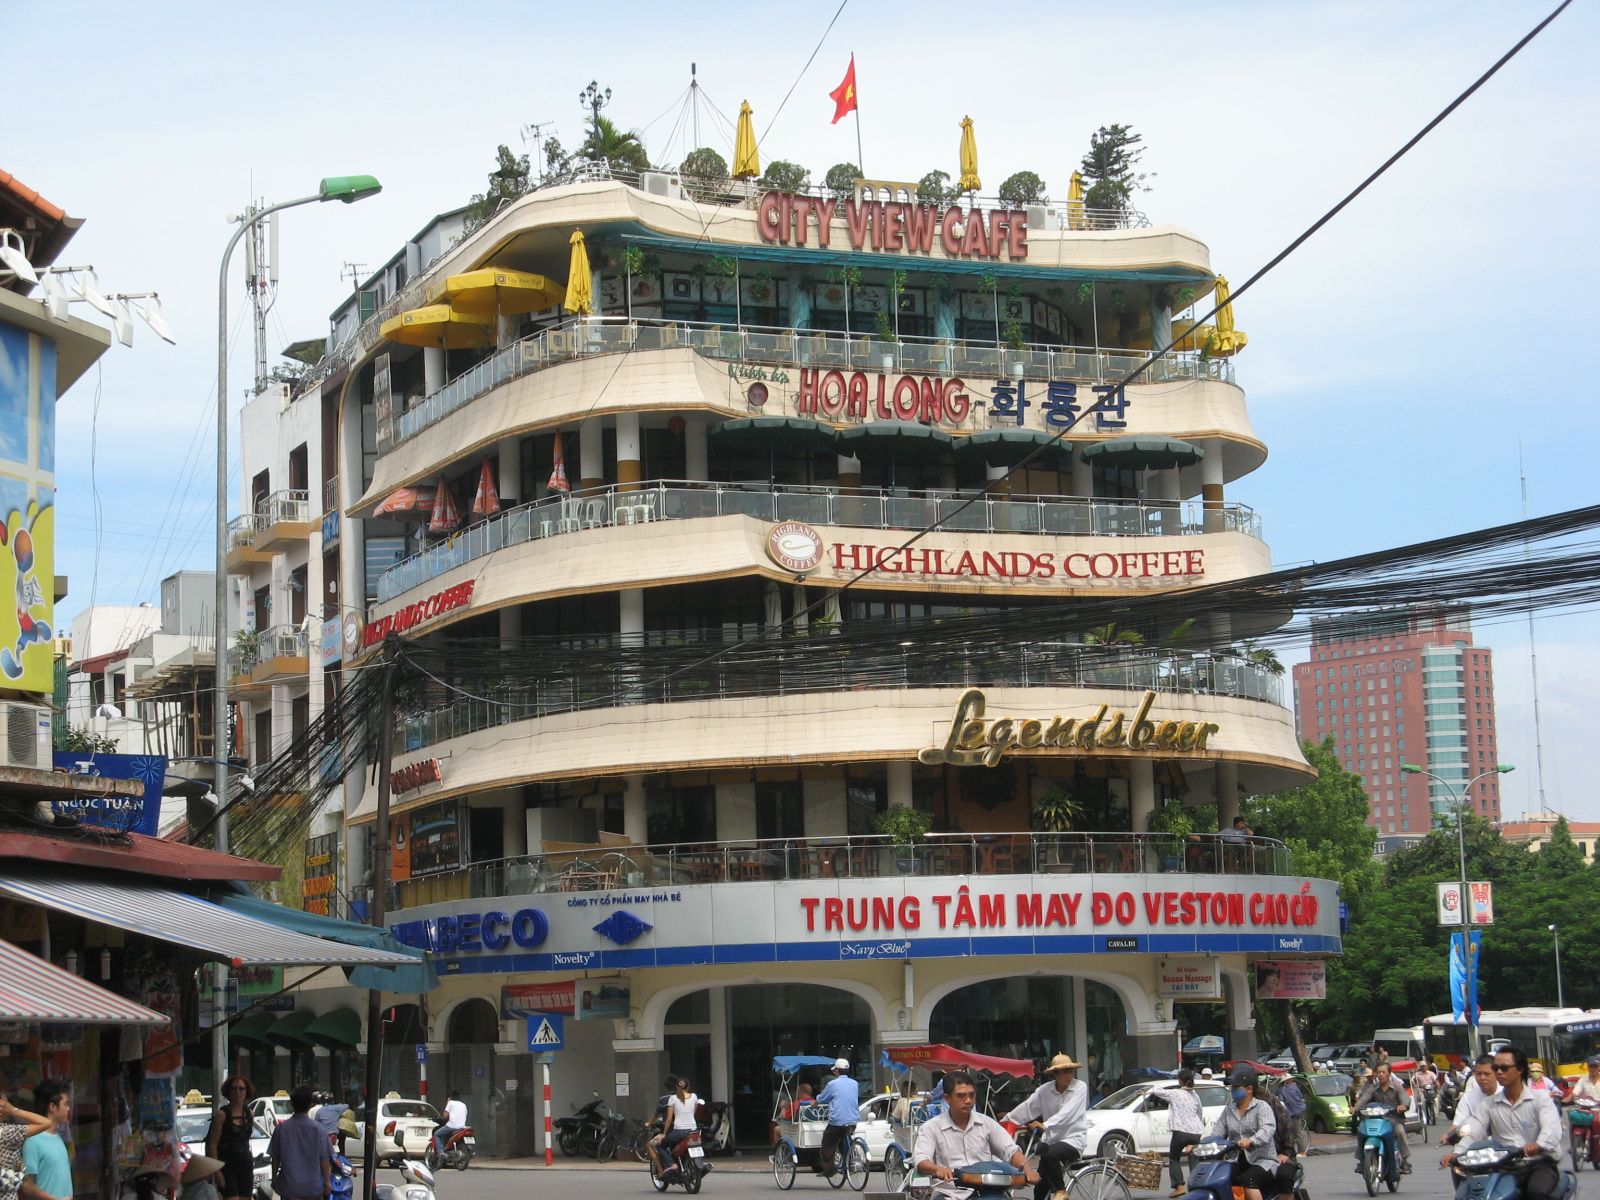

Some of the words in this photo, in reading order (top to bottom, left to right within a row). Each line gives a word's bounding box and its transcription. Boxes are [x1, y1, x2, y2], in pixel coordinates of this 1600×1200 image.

[757, 190, 833, 248] CITY
[844, 196, 938, 253] VIEW
[940, 204, 1029, 260] CAFE
[800, 368, 868, 418] HOA
[877, 373, 970, 423] LONG
[771, 523, 820, 546] HIGHLANDS
[780, 554, 818, 569] COFFEE
[831, 543, 1055, 578] HIGHLANDS
[1063, 548, 1206, 579] COFFEE
[567, 896, 588, 908] CÔNG
[589, 898, 599, 906] TY
[634, 895, 650, 904] MAY
[800, 895, 921, 931] TRUNG
[932, 884, 1007, 929] TÂM
[1016, 893, 1082, 928] MAY
[1142, 892, 1246, 926] VESTON
[1250, 892, 1289, 927] CAO
[841, 943, 875, 958] Navy
[1108, 940, 1136, 948] CAVALDI
